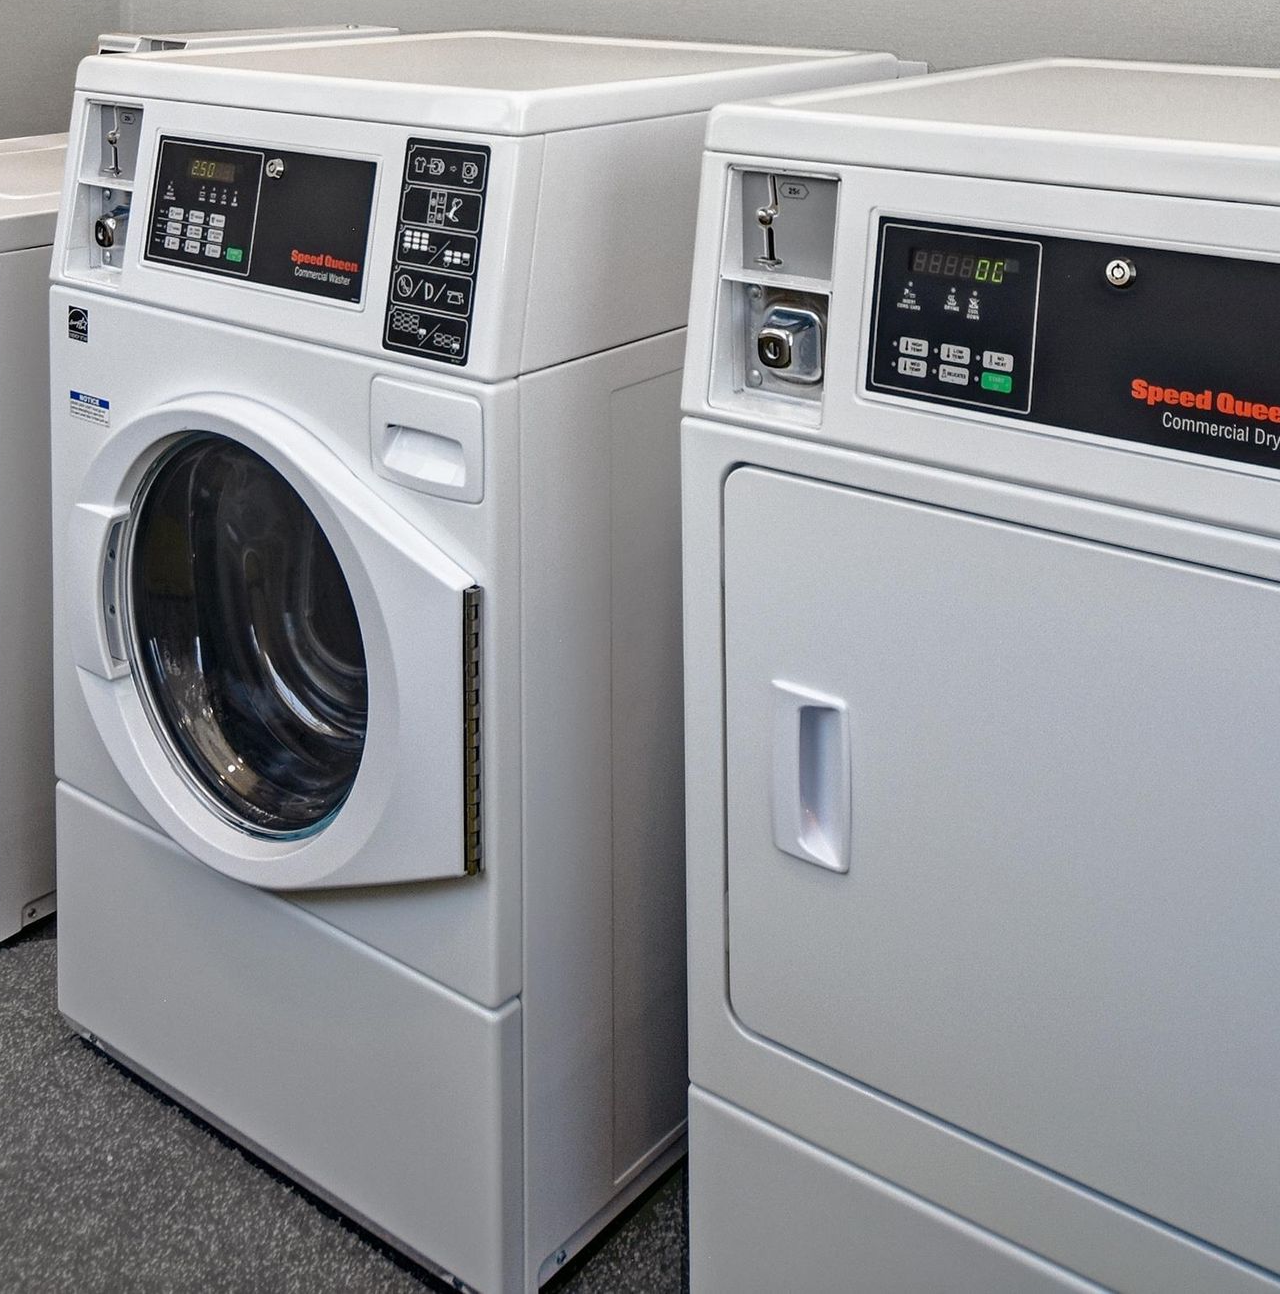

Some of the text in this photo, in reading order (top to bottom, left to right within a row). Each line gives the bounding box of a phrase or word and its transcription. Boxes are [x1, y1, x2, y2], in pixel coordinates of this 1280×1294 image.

[291, 249, 358, 272] Speed Queen
[294, 266, 351, 286] Commercial Washer
[1131, 378, 1212, 411] Speed
[1162, 411, 1249, 442] Commercial
